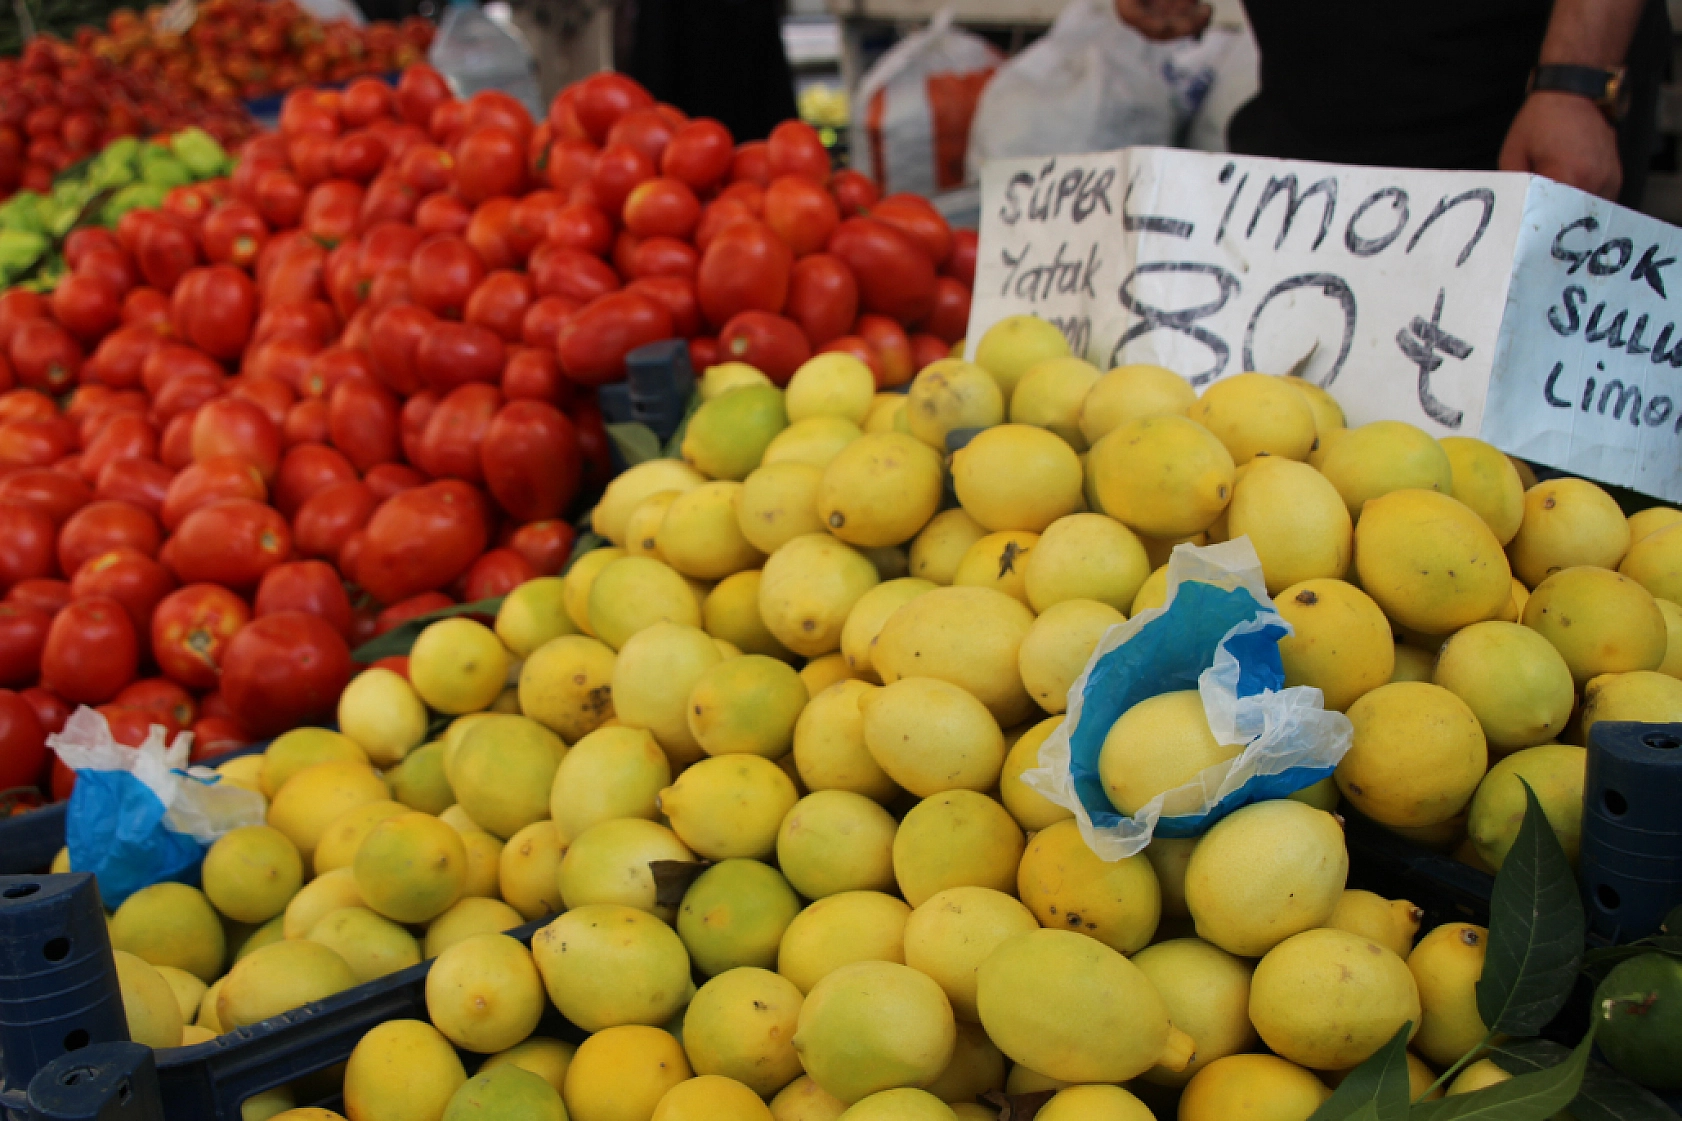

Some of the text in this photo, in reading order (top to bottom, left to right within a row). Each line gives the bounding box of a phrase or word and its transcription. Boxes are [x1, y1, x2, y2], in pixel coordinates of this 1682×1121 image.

[1000, 157, 1116, 224] SÜPER
[1122, 161, 1496, 267] Limon
[1109, 261, 1357, 388] 80
